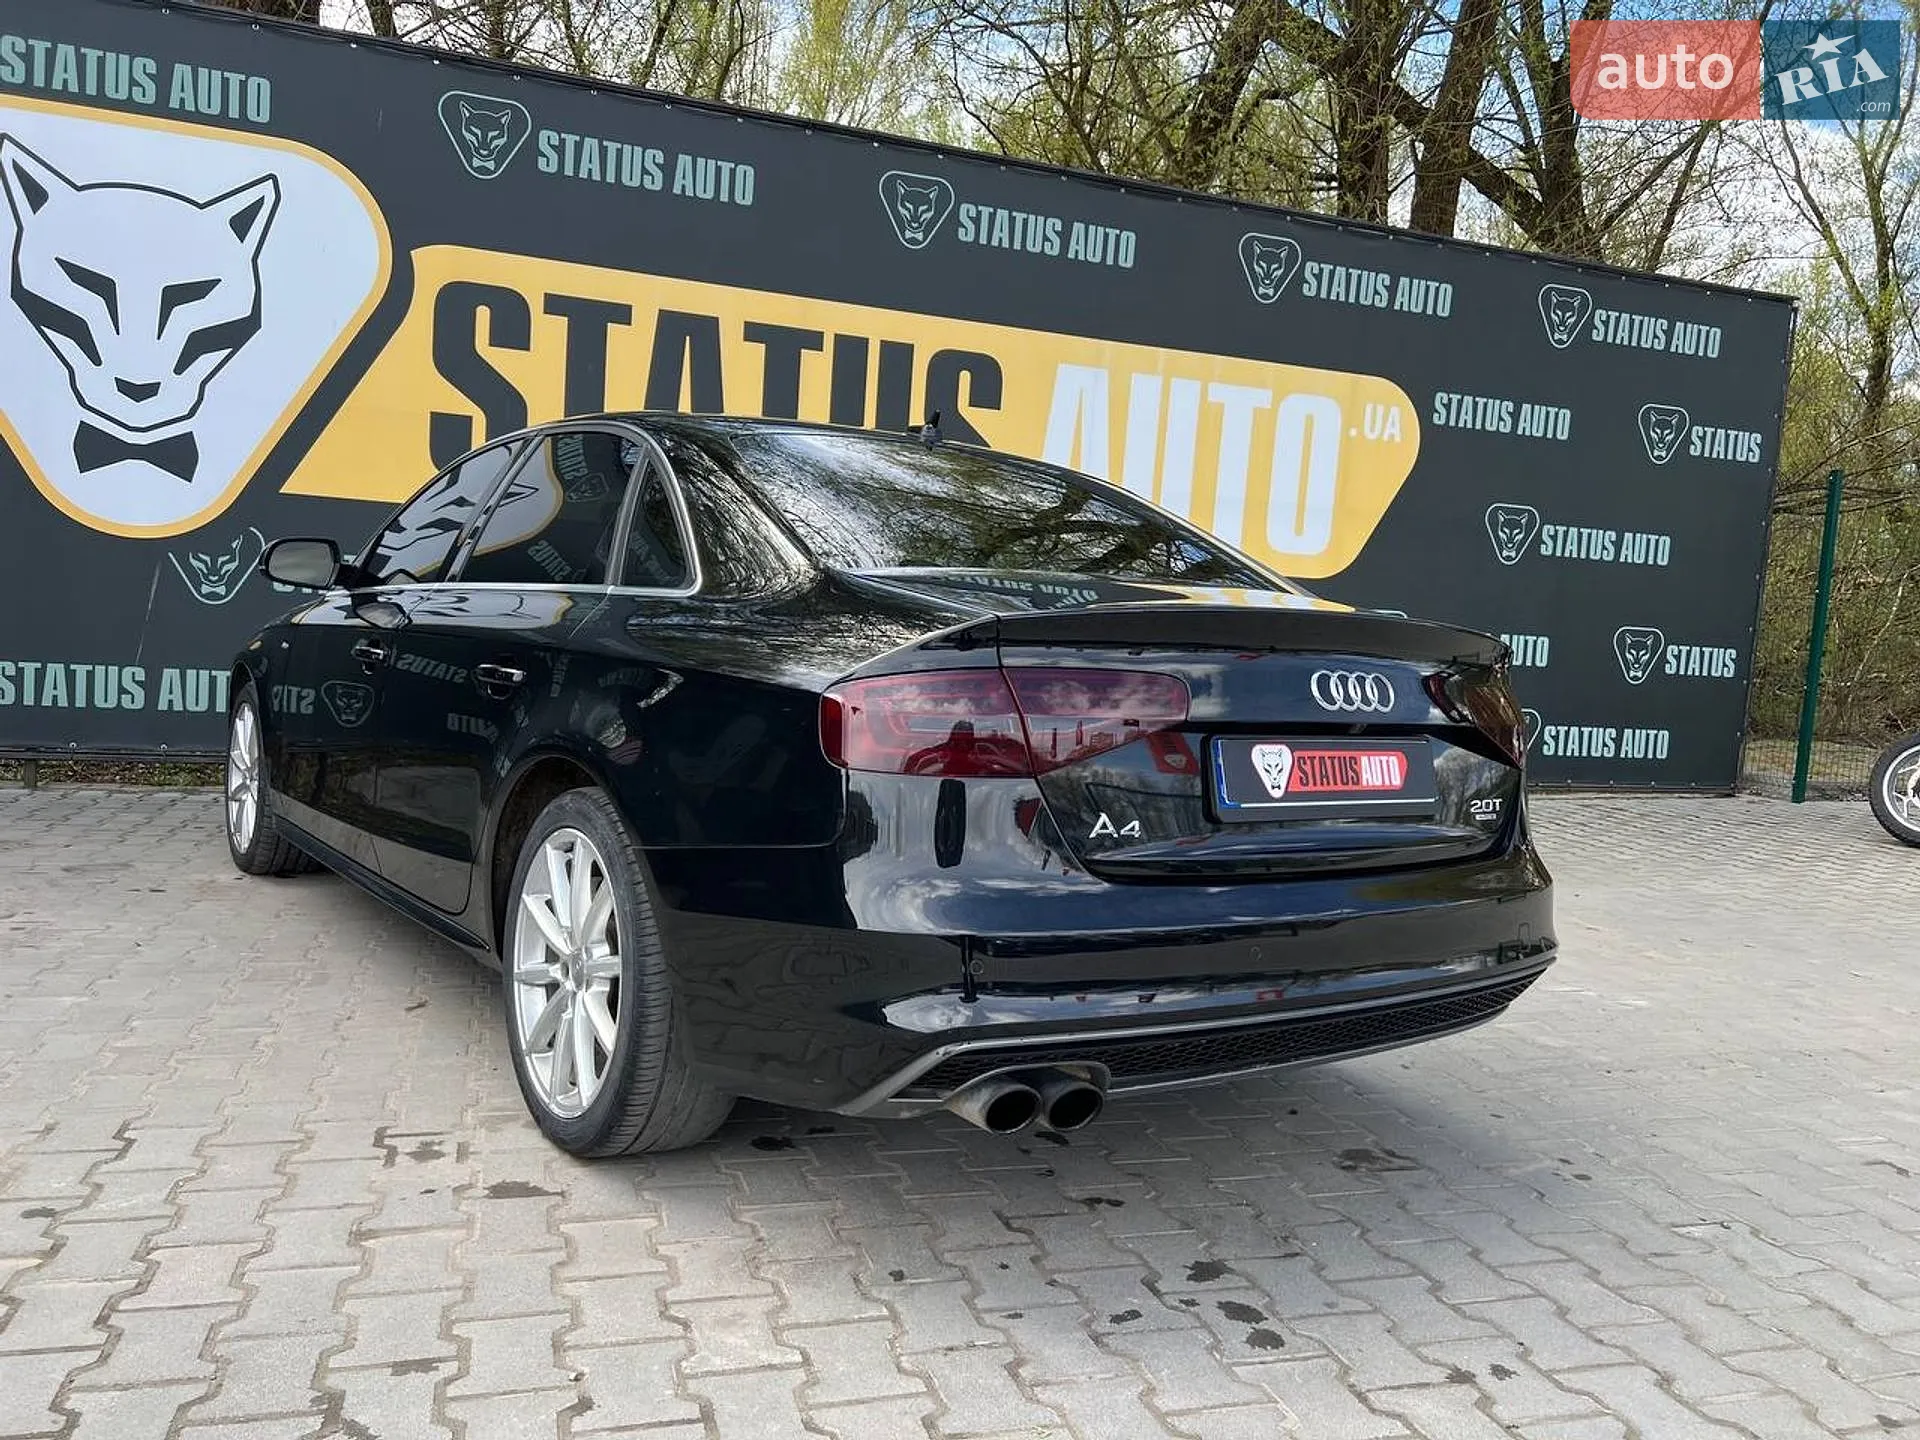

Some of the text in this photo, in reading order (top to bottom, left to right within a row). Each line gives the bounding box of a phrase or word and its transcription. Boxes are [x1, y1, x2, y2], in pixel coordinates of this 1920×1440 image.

[0, 35, 271, 123] STATUS AUTO
[537, 130, 755, 206] STATUS AUTO
[957, 202, 1137, 269] STATUS AUTO
[1302, 261, 1453, 318] STATUS AUTO
[1591, 309, 1722, 359] STATUS AUTO
[1432, 391, 1571, 441] STATUS AUTO
[1043, 363, 1342, 556] AUTO
[1689, 425, 1762, 463] STATUS
[1540, 524, 1671, 566] STATUS AUTO
[1501, 634, 1550, 668] UTO
[1664, 644, 1737, 678] STATUS
[0, 661, 146, 710] STATUS
[157, 668, 231, 713] AUT
[1542, 725, 1670, 759] STATUS AUTO
[1297, 755, 1401, 787] STATUS AUTO
[1089, 812, 1141, 838] A4
